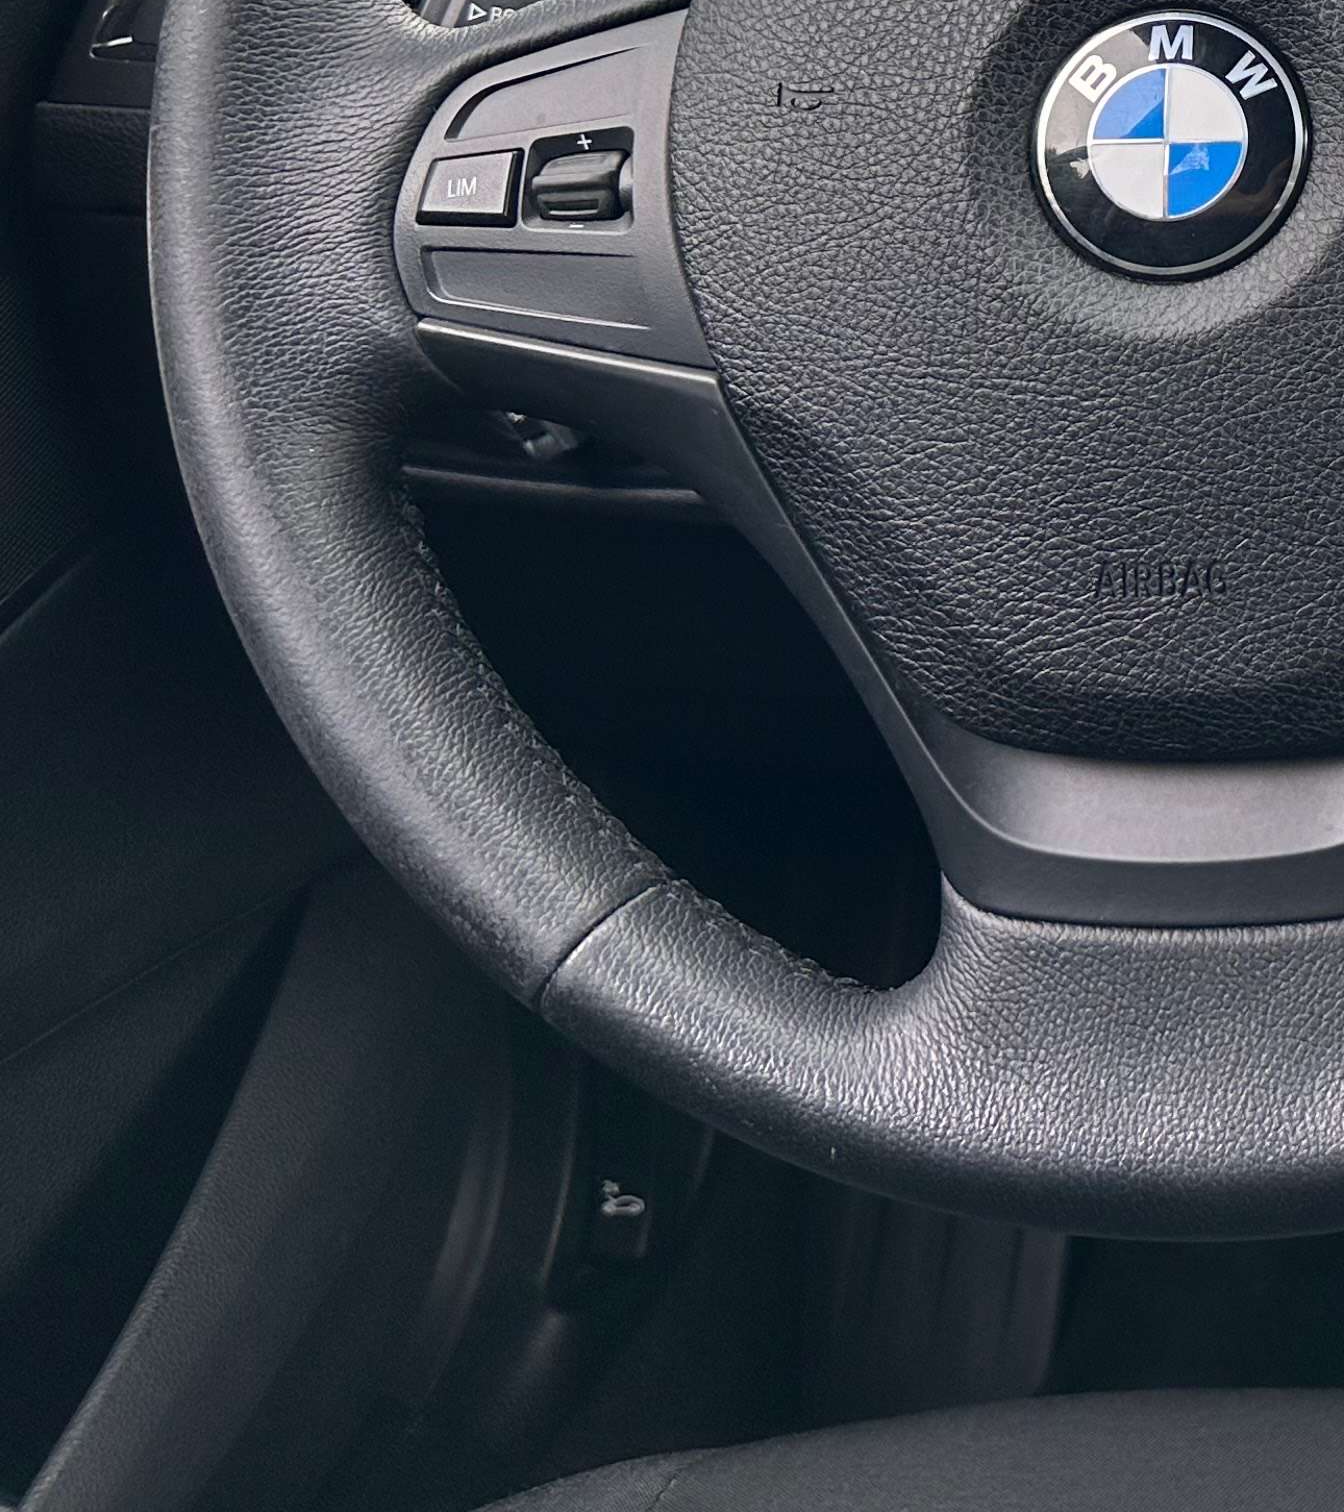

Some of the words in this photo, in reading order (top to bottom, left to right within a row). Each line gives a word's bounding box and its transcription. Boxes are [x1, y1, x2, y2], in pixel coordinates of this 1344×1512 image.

[1068, 24, 1278, 103] BMW
[446, 176, 478, 199] LIM
[1095, 558, 1228, 599] AIRBAG
